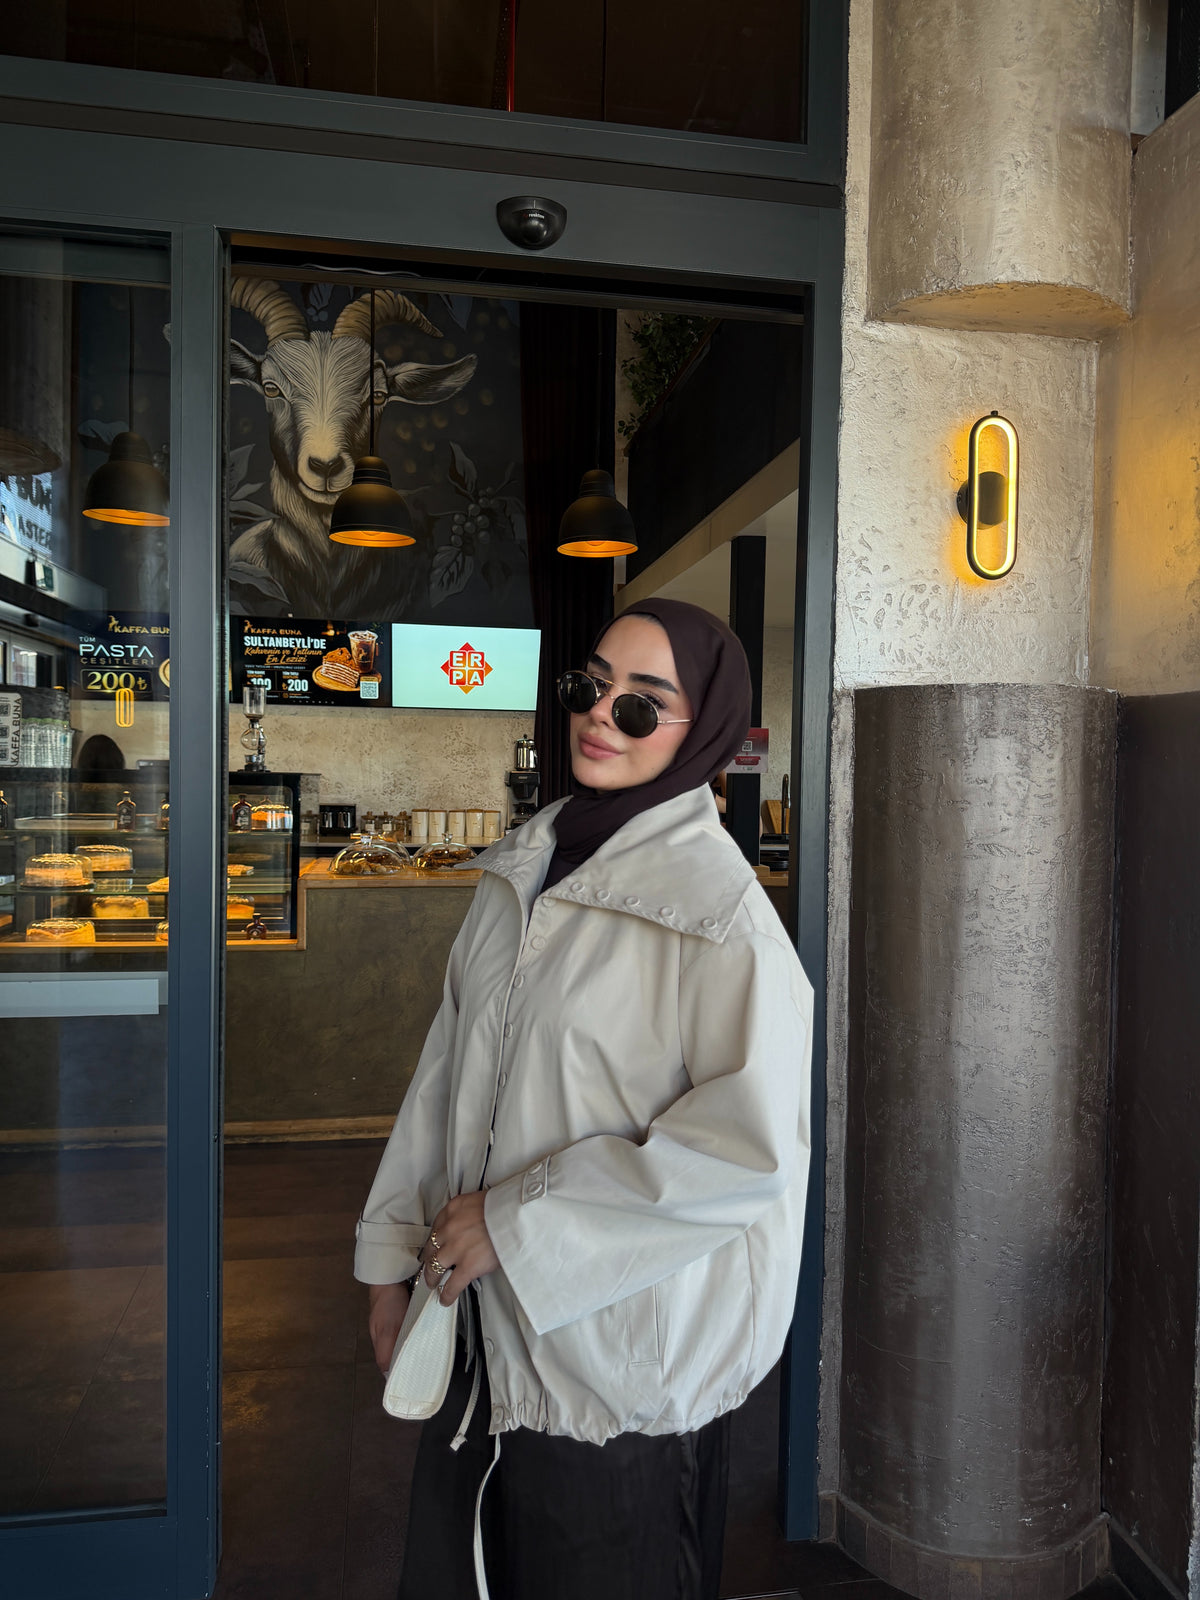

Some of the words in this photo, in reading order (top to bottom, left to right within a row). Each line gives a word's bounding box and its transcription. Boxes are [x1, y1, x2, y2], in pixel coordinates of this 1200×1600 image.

[114, 626, 149, 634] KAFFA
[79, 644, 154, 658] PASTA
[12, 697, 22, 727] BUNA
[10, 729, 21, 764] KAFFA
